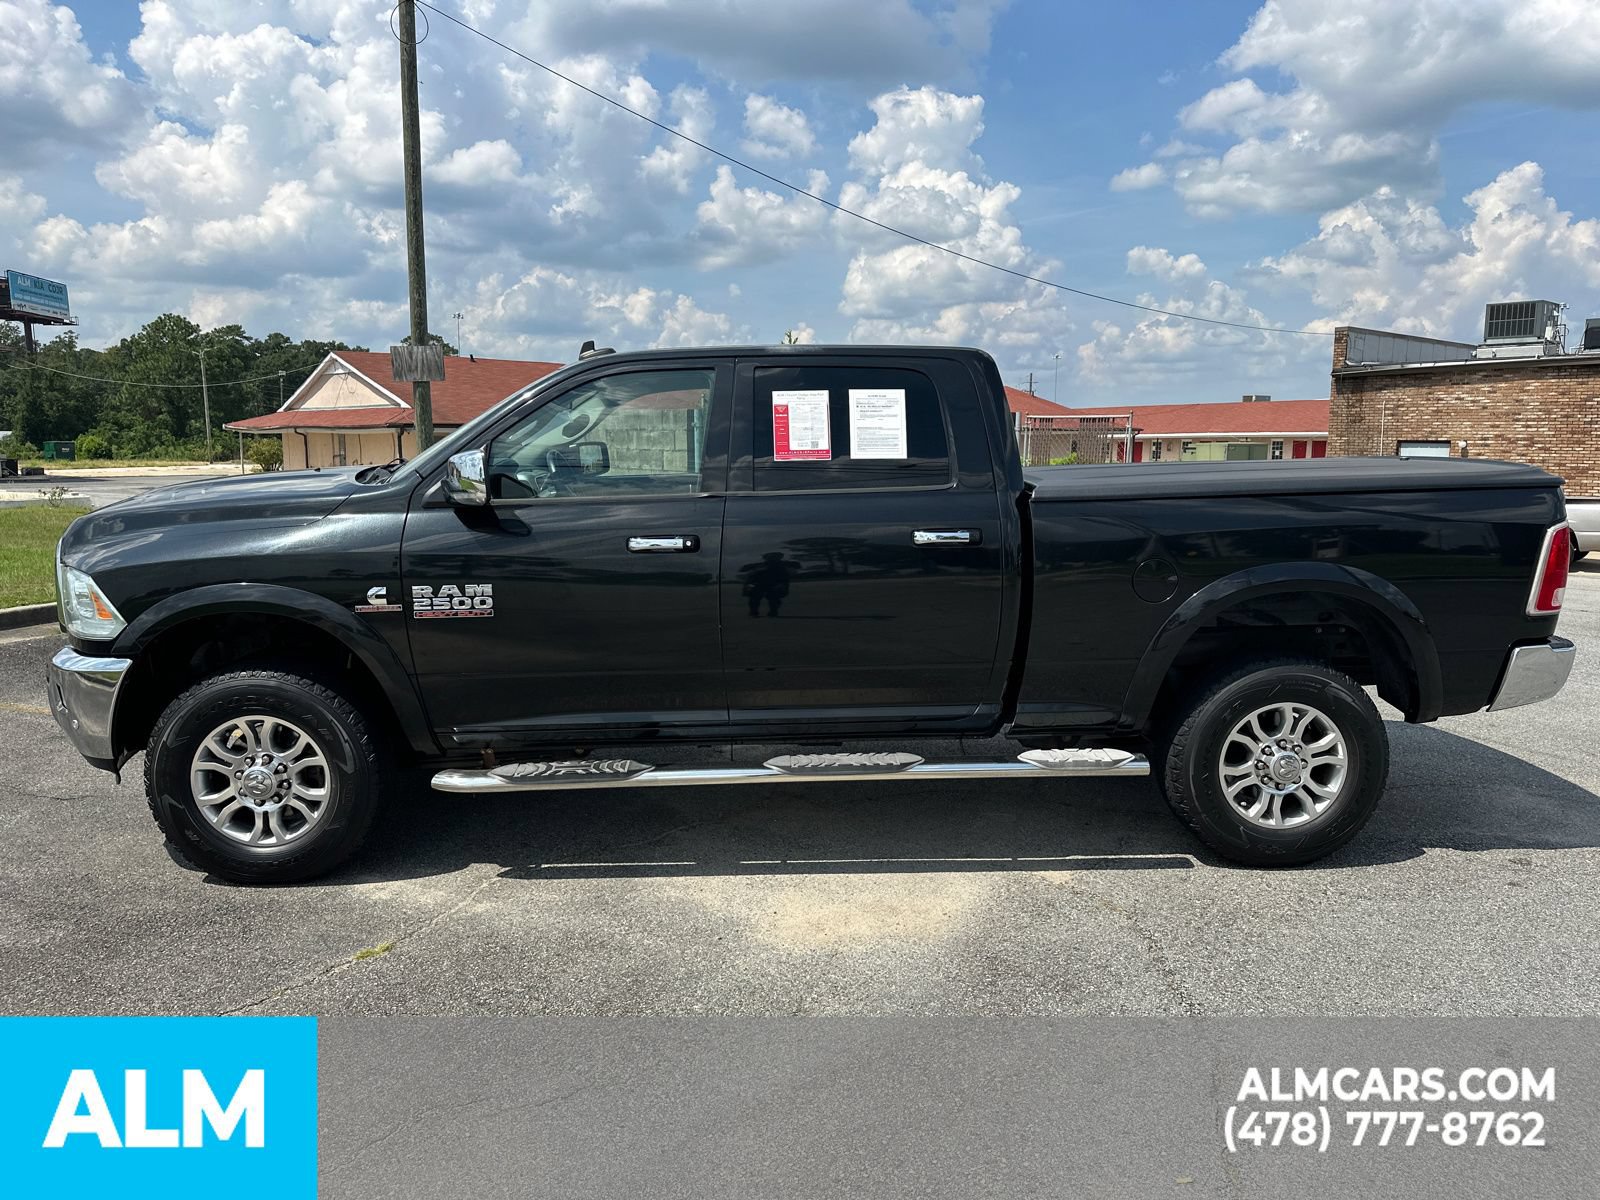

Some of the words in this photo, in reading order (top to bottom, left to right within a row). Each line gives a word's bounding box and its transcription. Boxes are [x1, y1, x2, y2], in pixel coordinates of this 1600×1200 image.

[17, 276, 30, 287] ALM
[411, 584, 493, 598] RAM
[413, 597, 494, 610] 2500
[416, 610, 455, 618] HEAVY
[457, 609, 491, 617] DUTY
